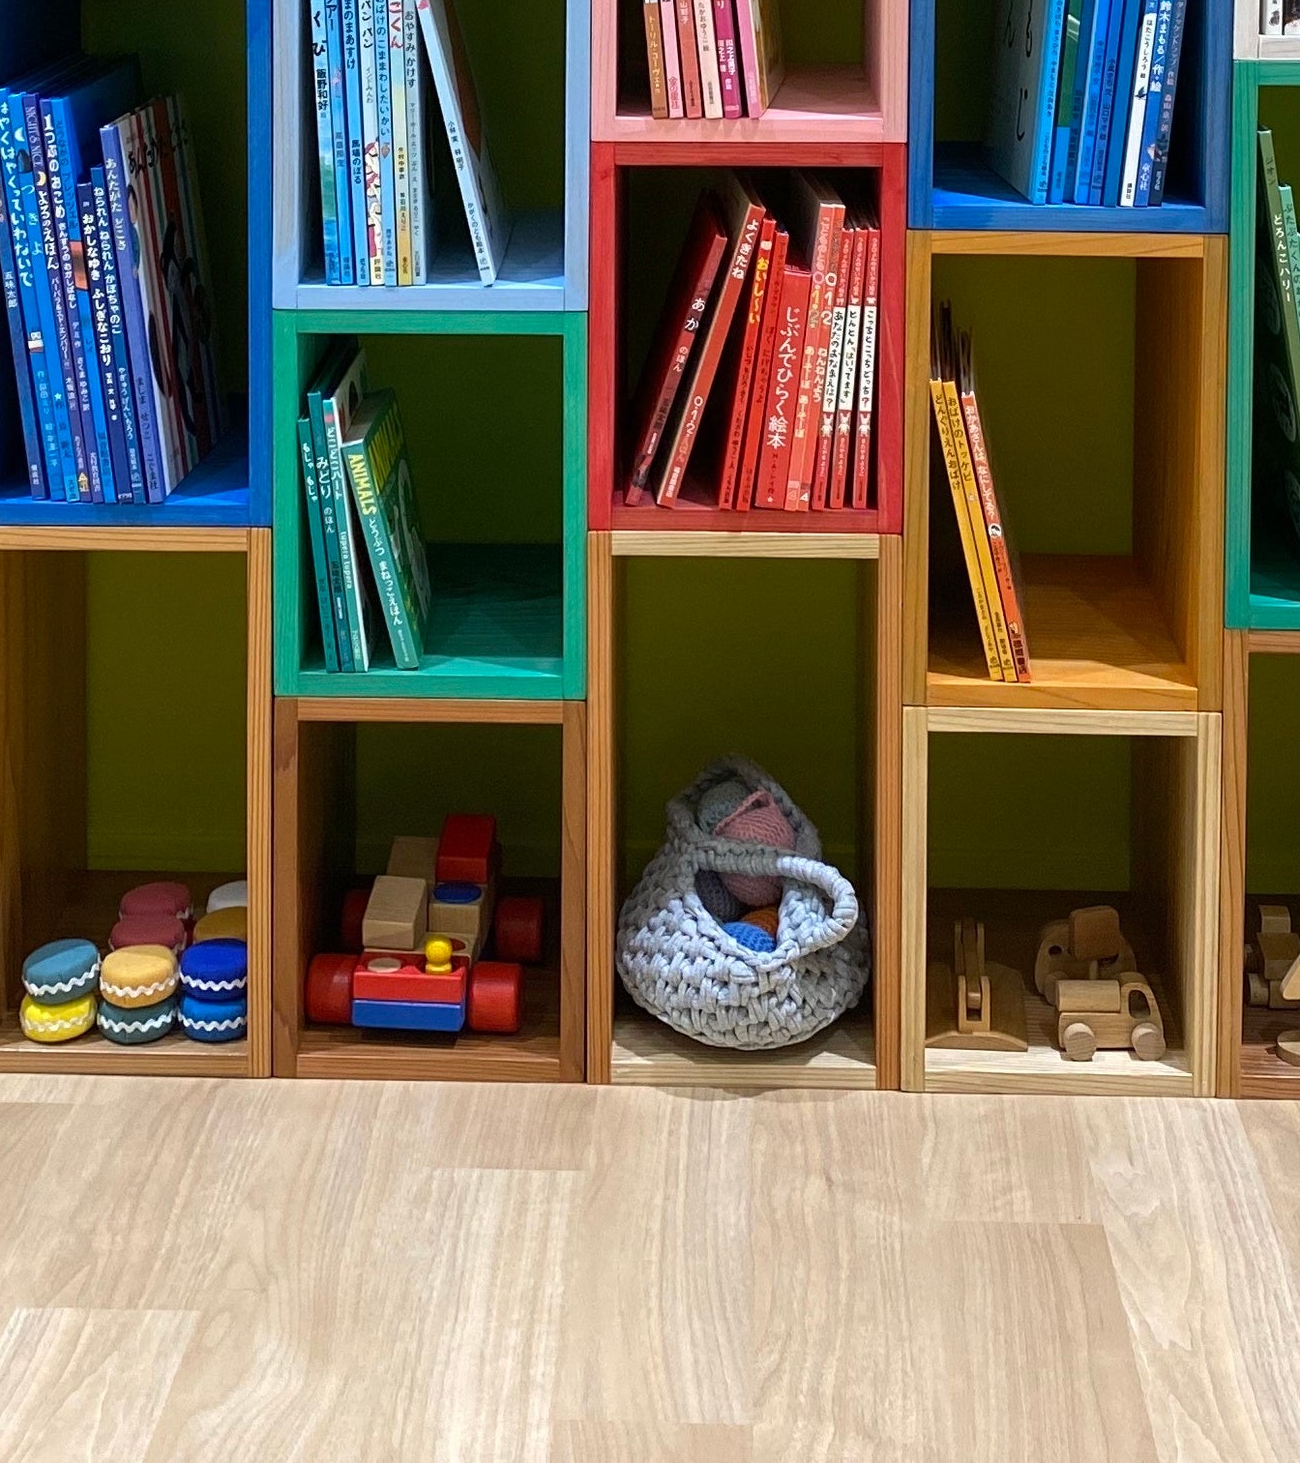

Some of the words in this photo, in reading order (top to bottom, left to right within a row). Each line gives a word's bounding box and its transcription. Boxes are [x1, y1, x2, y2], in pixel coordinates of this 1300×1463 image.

[43, 114, 60, 173] 1つぶの
[351, 139, 362, 185] 馬場のぼる
[50, 177, 66, 219] おこめ
[105, 157, 123, 212] あんたがた
[38, 190, 60, 271] よるのえほん
[731, 217, 761, 281] よくきたね
[1273, 212, 1292, 303] どろんこハリー
[81, 213, 101, 282] おかしなゆき
[91, 288, 112, 367] ふしぎなこおり
[103, 273, 123, 335] かぼちゃのこ
[766, 306, 801, 450] じぶんでひらく絵本
[934, 393, 962, 491] どんぐりえんおばけ
[947, 395, 973, 482] おばけのトッケビ
[347, 454, 377, 515] ANIMALS
